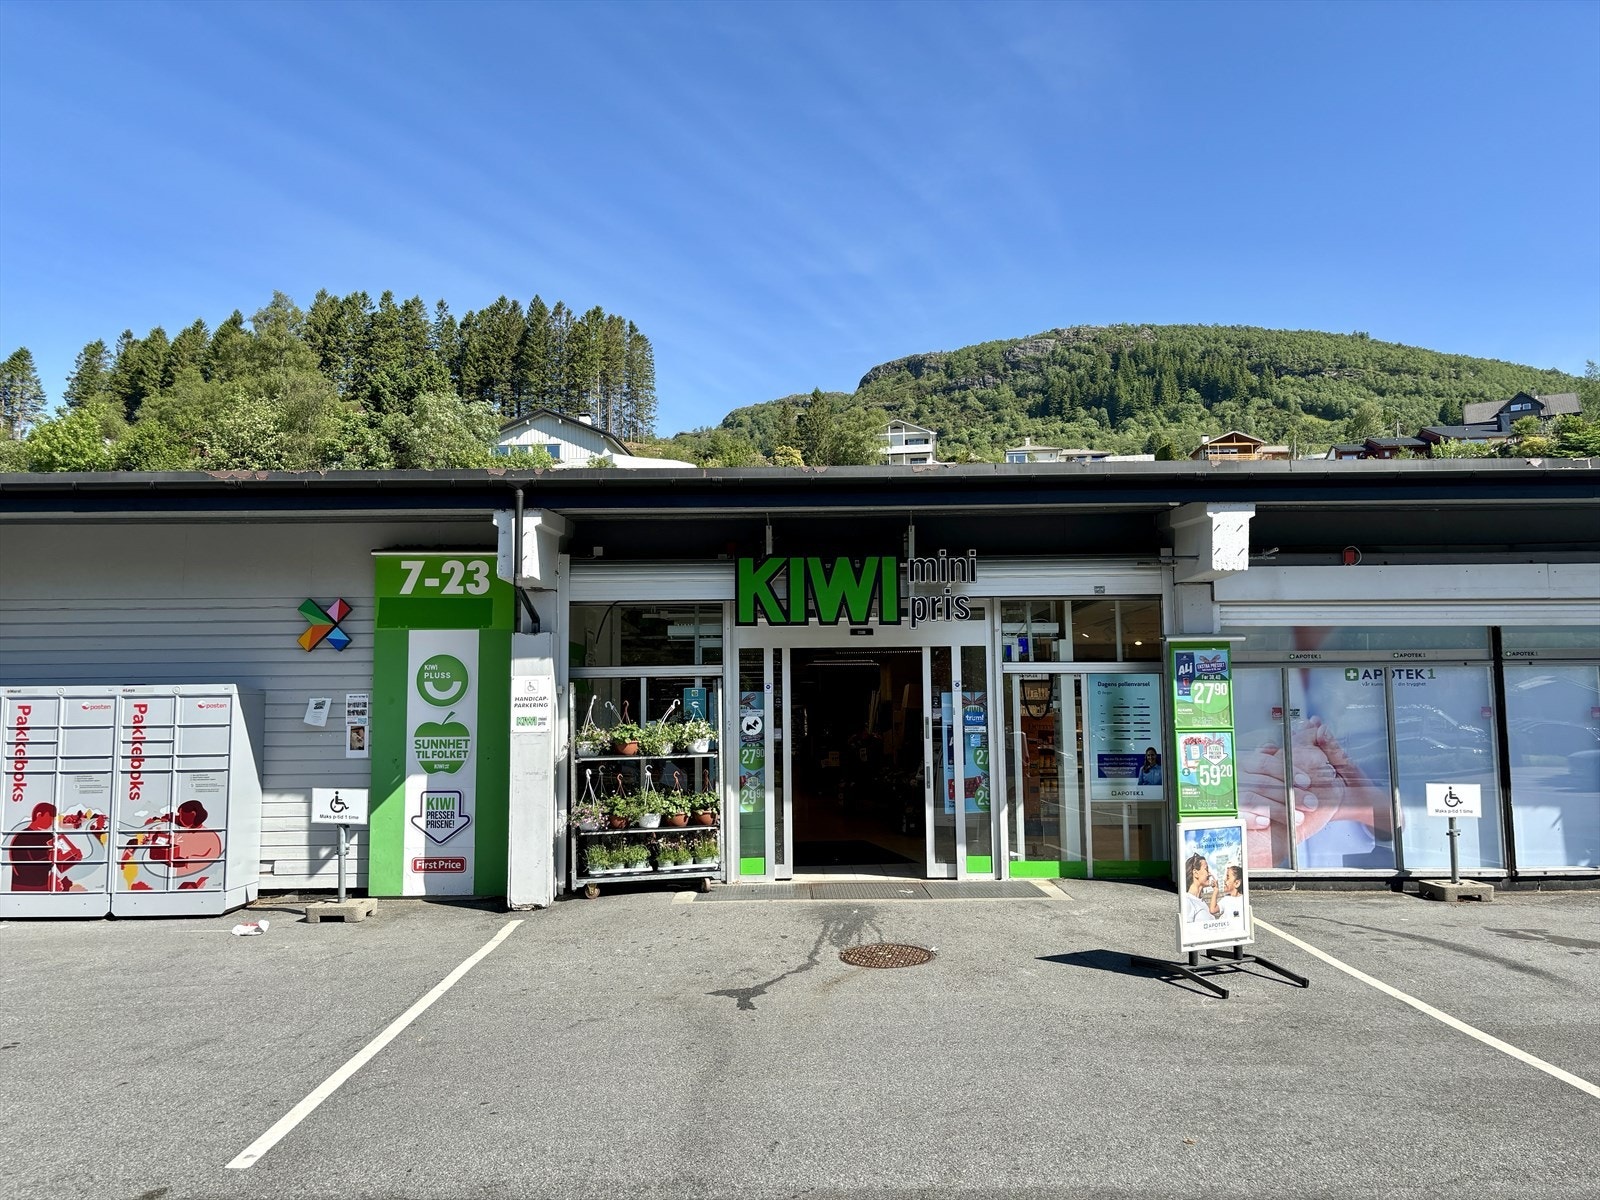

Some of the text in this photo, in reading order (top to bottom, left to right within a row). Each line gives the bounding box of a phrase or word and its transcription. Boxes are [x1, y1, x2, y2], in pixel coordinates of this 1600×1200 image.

[908, 549, 977, 583] mini
[399, 560, 490, 595] 7-23
[735, 555, 901, 626] KIWI
[909, 587, 971, 629] pris
[1428, 668, 1436, 679] 1
[414, 738, 470, 750] SUNNHET
[12, 705, 32, 802] Pakkeboks
[128, 704, 148, 800] Pakkeboks
[416, 750, 469, 759] TIL FOLKET
[426, 798, 455, 810] KIWI
[426, 811, 455, 819] PRESSER
[426, 820, 455, 828] PRISENE!
[416, 860, 461, 870] First Price
